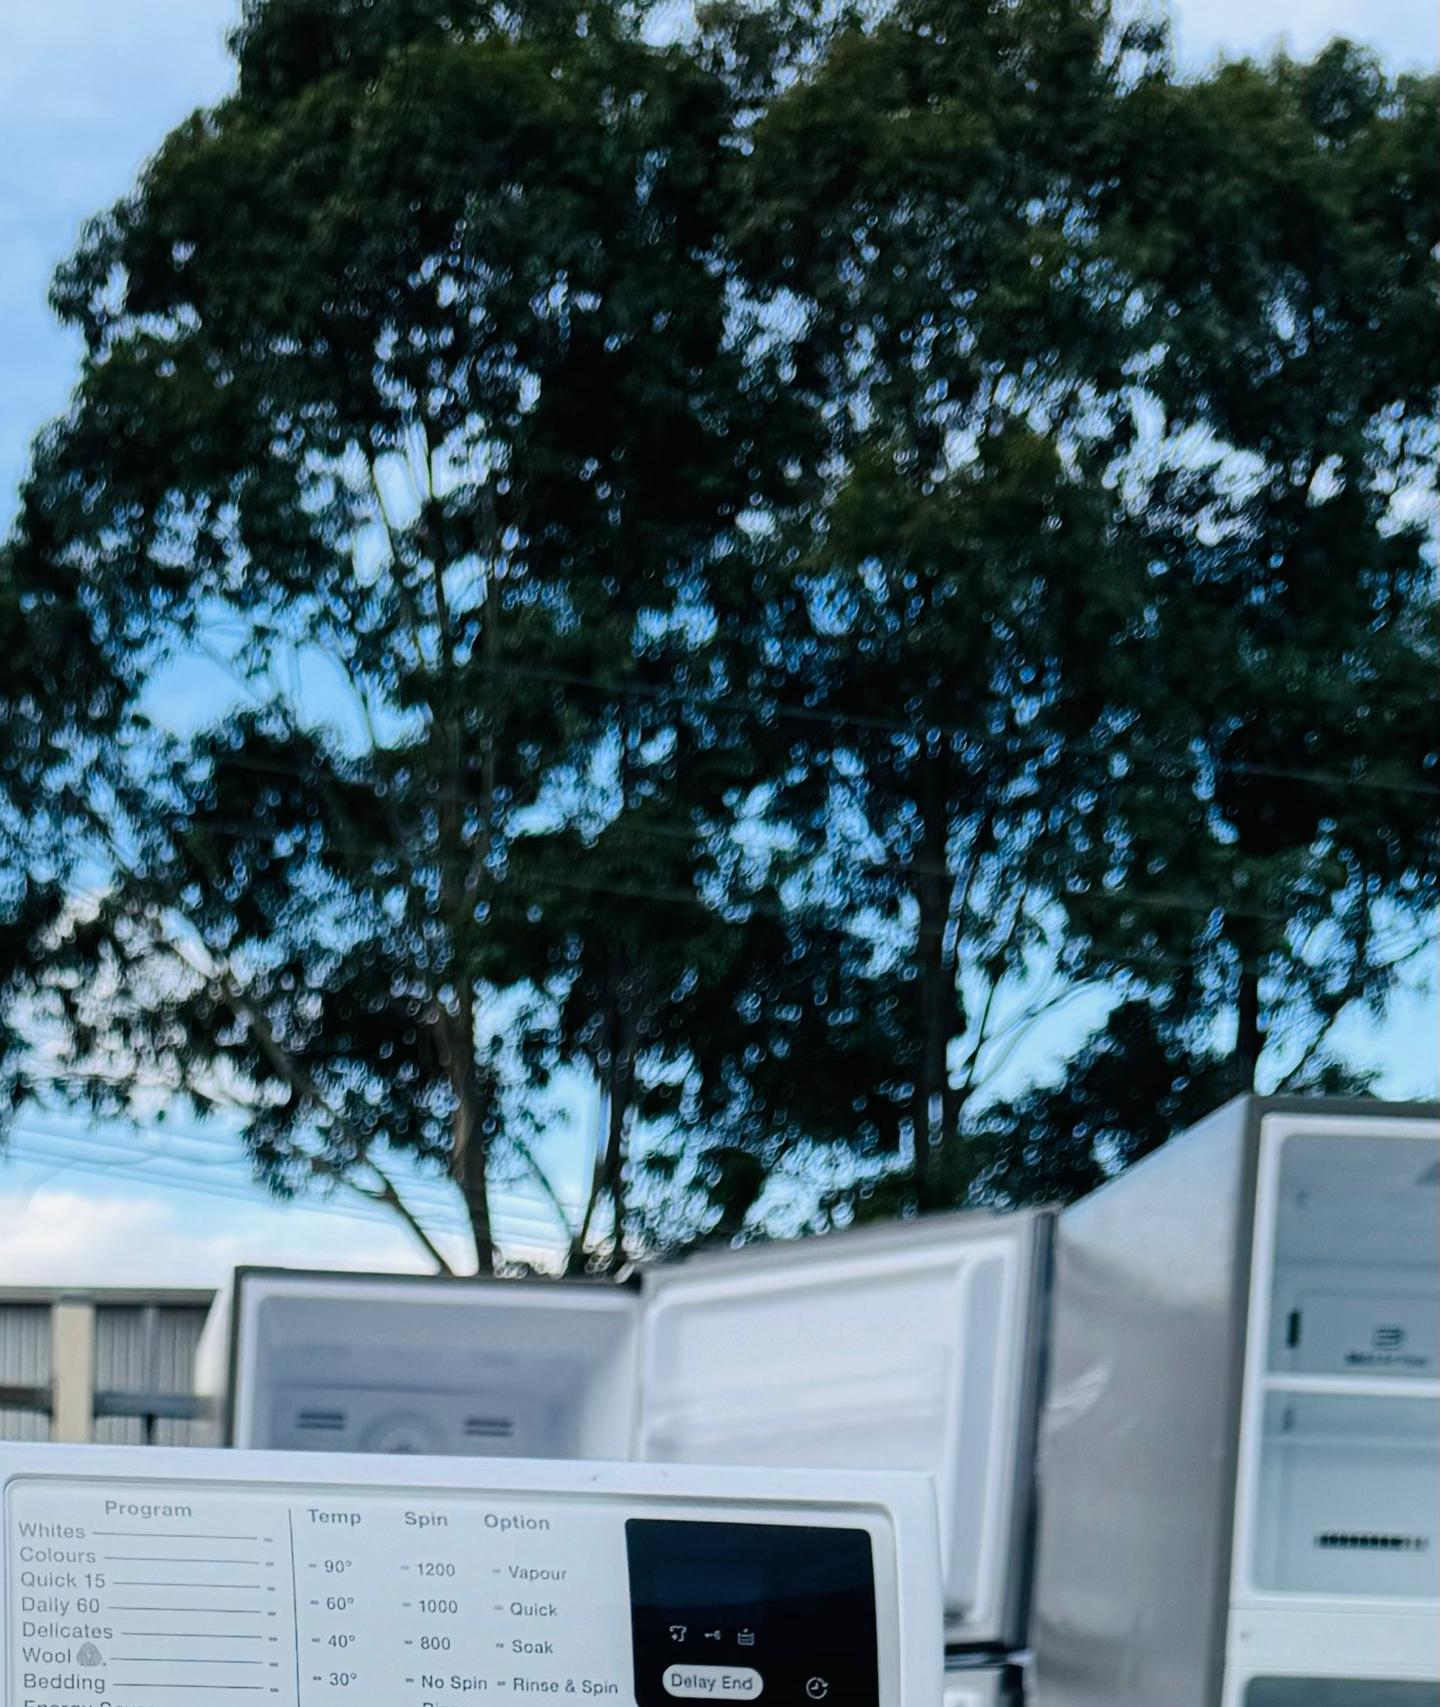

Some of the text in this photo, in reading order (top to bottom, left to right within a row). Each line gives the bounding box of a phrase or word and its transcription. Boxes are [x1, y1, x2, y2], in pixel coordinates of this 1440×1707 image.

[104, 1500, 193, 1519] Program
[307, 1509, 362, 1526] Temp
[404, 1511, 449, 1528] Spin
[484, 1513, 550, 1532] Option
[18, 1522, 86, 1539] Whites
[20, 1546, 97, 1564] Colours
[417, 1562, 456, 1577] 1200
[508, 1565, 568, 1582] Vapour
[21, 1571, 106, 1588] Quick 15
[21, 1596, 101, 1617] Daily 60
[418, 1599, 458, 1614] 1000
[510, 1602, 558, 1618] Quick
[22, 1621, 114, 1640] Delicates
[420, 1636, 451, 1651] 800
[512, 1639, 554, 1655] Soak
[22, 1647, 71, 1664] Wool
[23, 1673, 106, 1694] Bedding
[421, 1675, 488, 1692] No Spin
[513, 1677, 619, 1697] Rinse & Spin
[671, 1673, 753, 1692] Delay End
